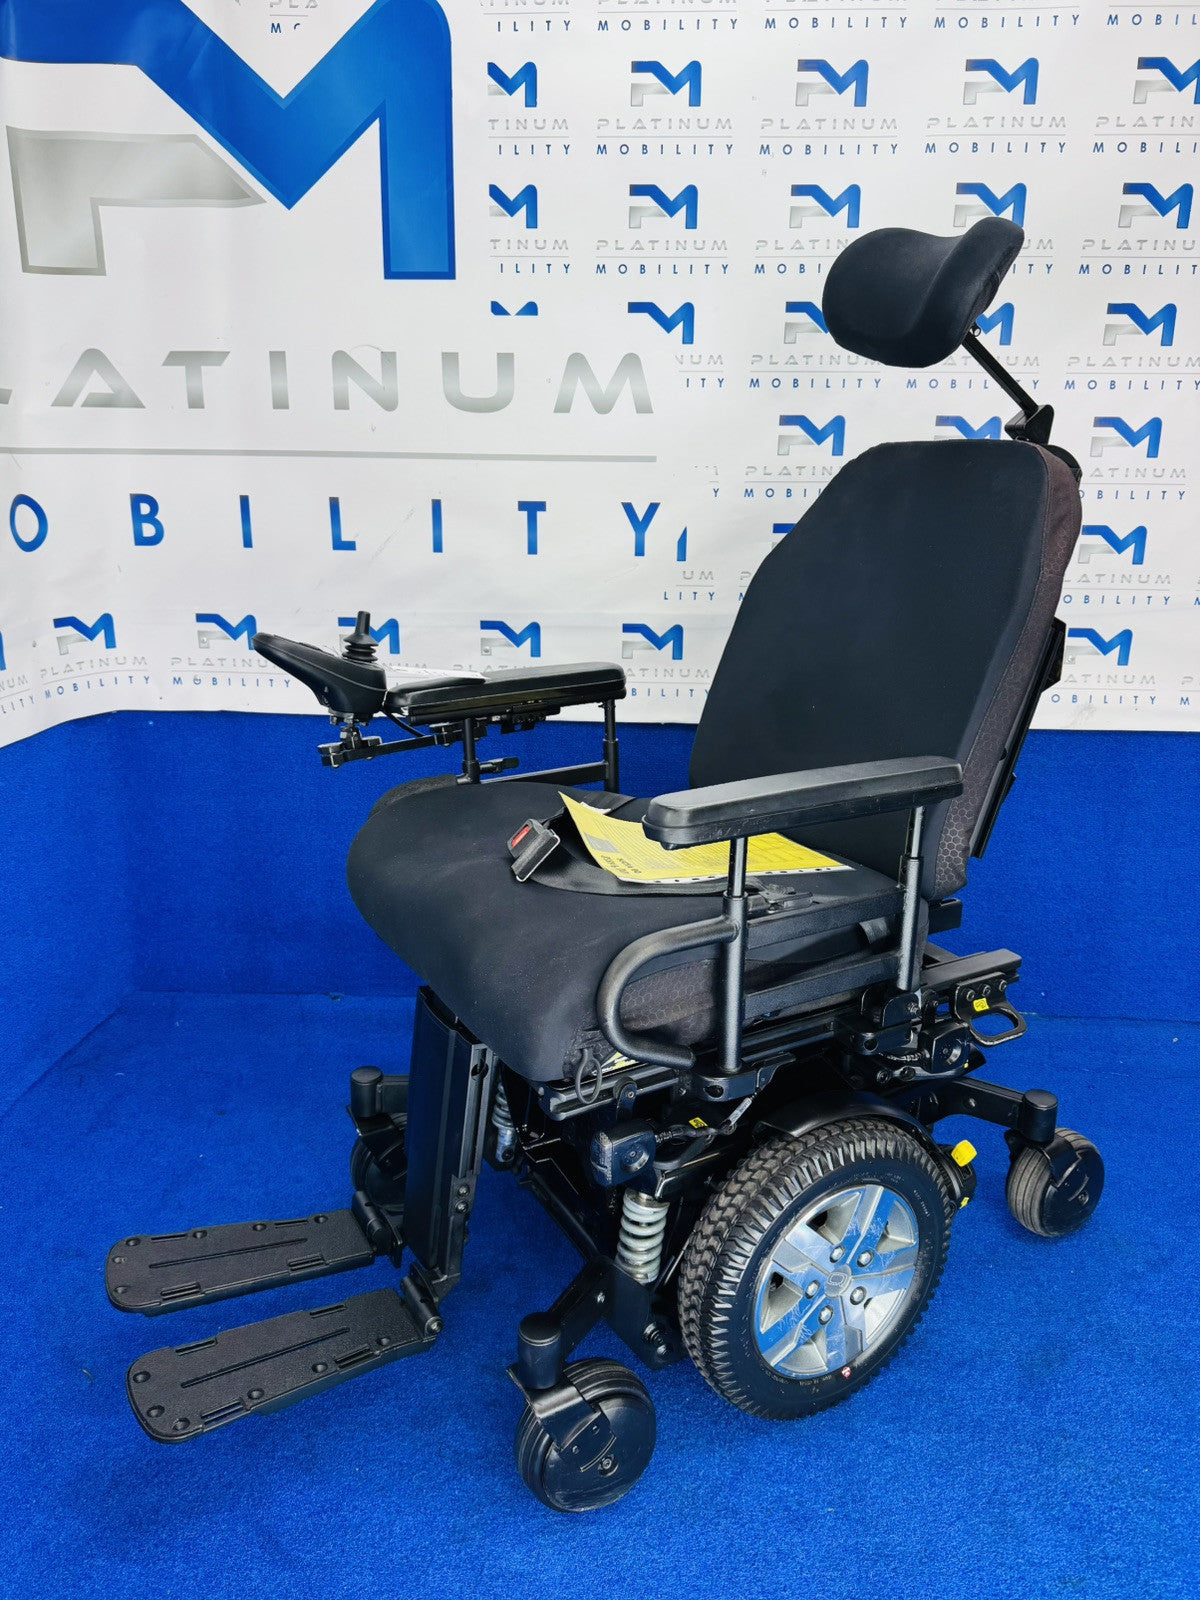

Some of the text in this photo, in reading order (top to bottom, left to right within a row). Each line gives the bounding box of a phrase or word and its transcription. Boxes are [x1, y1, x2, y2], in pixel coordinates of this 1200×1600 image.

[597, 18, 738, 31] MOBILITY
[764, 16, 907, 29] MOBILITY
[933, 14, 1080, 28] MOBILITY
[1107, 13, 1197, 26] MOBIL
[597, 118, 733, 130] PLATINUM
[760, 117, 898, 130] PLATINUM
[926, 116, 1067, 129] PLATINUM
[1095, 116, 1195, 128] PLATIN
[597, 144, 733, 155] MOBILITY
[759, 144, 898, 156] MOBILITY
[925, 142, 1067, 154] MOBILITY
[1092, 142, 1198, 153] MOBILI
[596, 239, 728, 251] PLATINUM
[596, 263, 729, 275] MOBILITY
[1079, 263, 1198, 275] MOBILIT
[1067, 356, 1200, 367] PLATINUM
[749, 378, 882, 388] MOBILITY
[906, 379, 1040, 389] MOBILY
[1064, 380, 1200, 390] MOBILITY
[744, 466, 842, 476] PLATIN
[9, 493, 661, 556] OBILITY
[1063, 594, 1171, 605] OBILITY
[40, 656, 147, 679] PLATINUM
[170, 656, 277, 668] PLATINU
[44, 675, 150, 699] MOBILITY
[172, 676, 291, 688] MOBILITY
[1051, 694, 1157, 705] OBILITY
